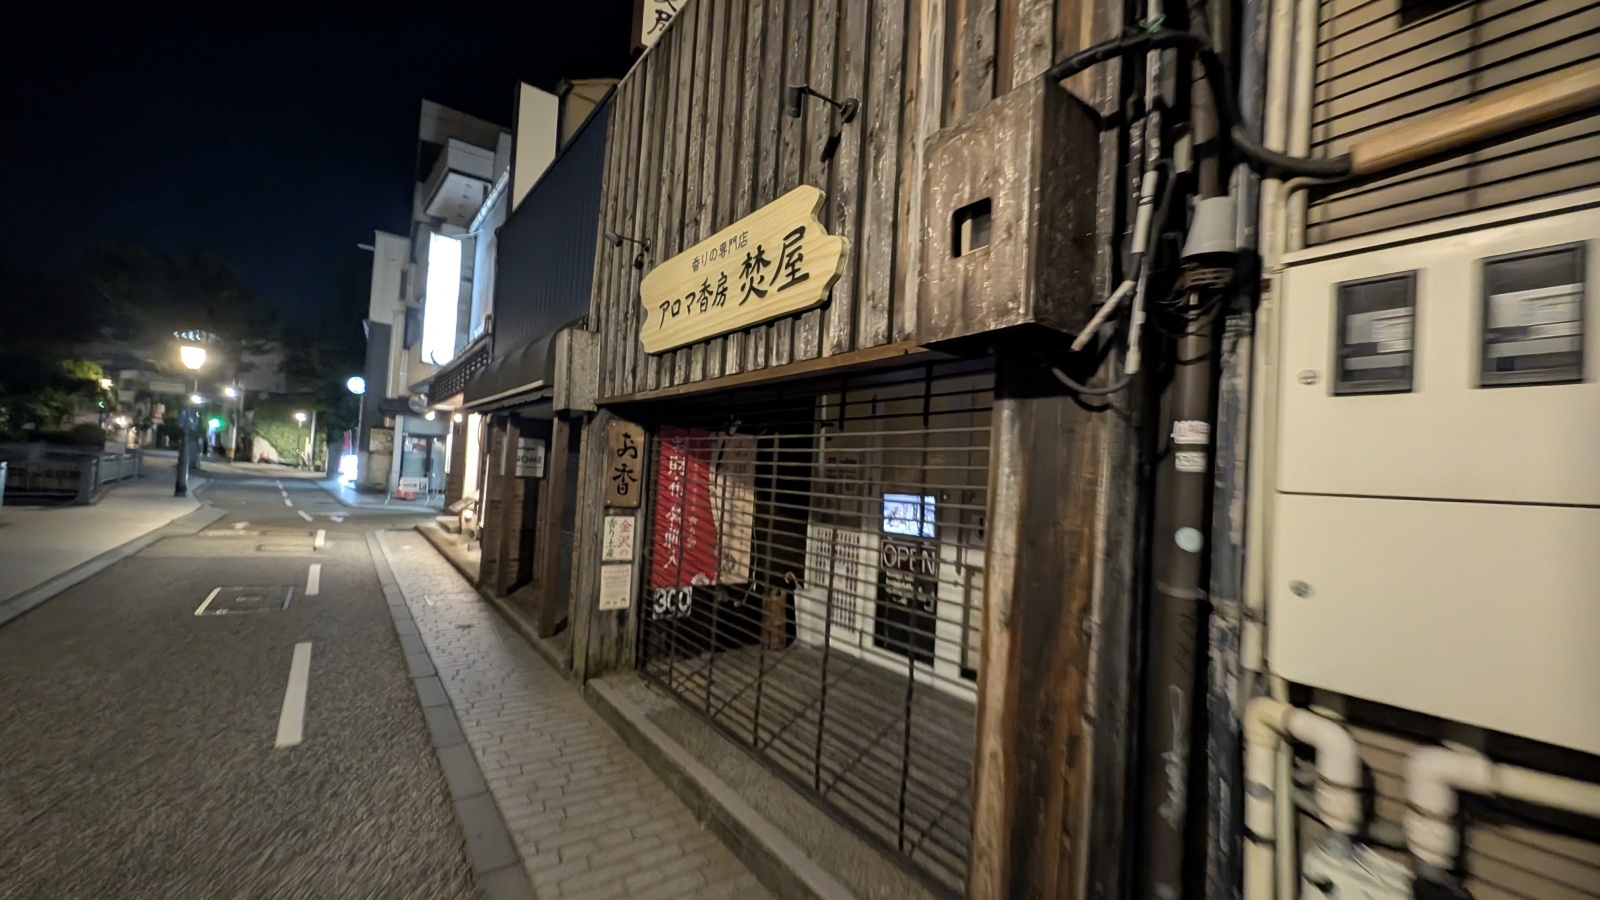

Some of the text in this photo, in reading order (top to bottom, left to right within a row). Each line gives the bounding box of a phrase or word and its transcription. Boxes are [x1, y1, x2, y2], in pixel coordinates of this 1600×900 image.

[659, 225, 810, 330] アロマ香房 焚屋
[691, 230, 749, 273] 香りの専門店
[612, 432, 638, 495] お香
[883, 543, 936, 576] OPEN
